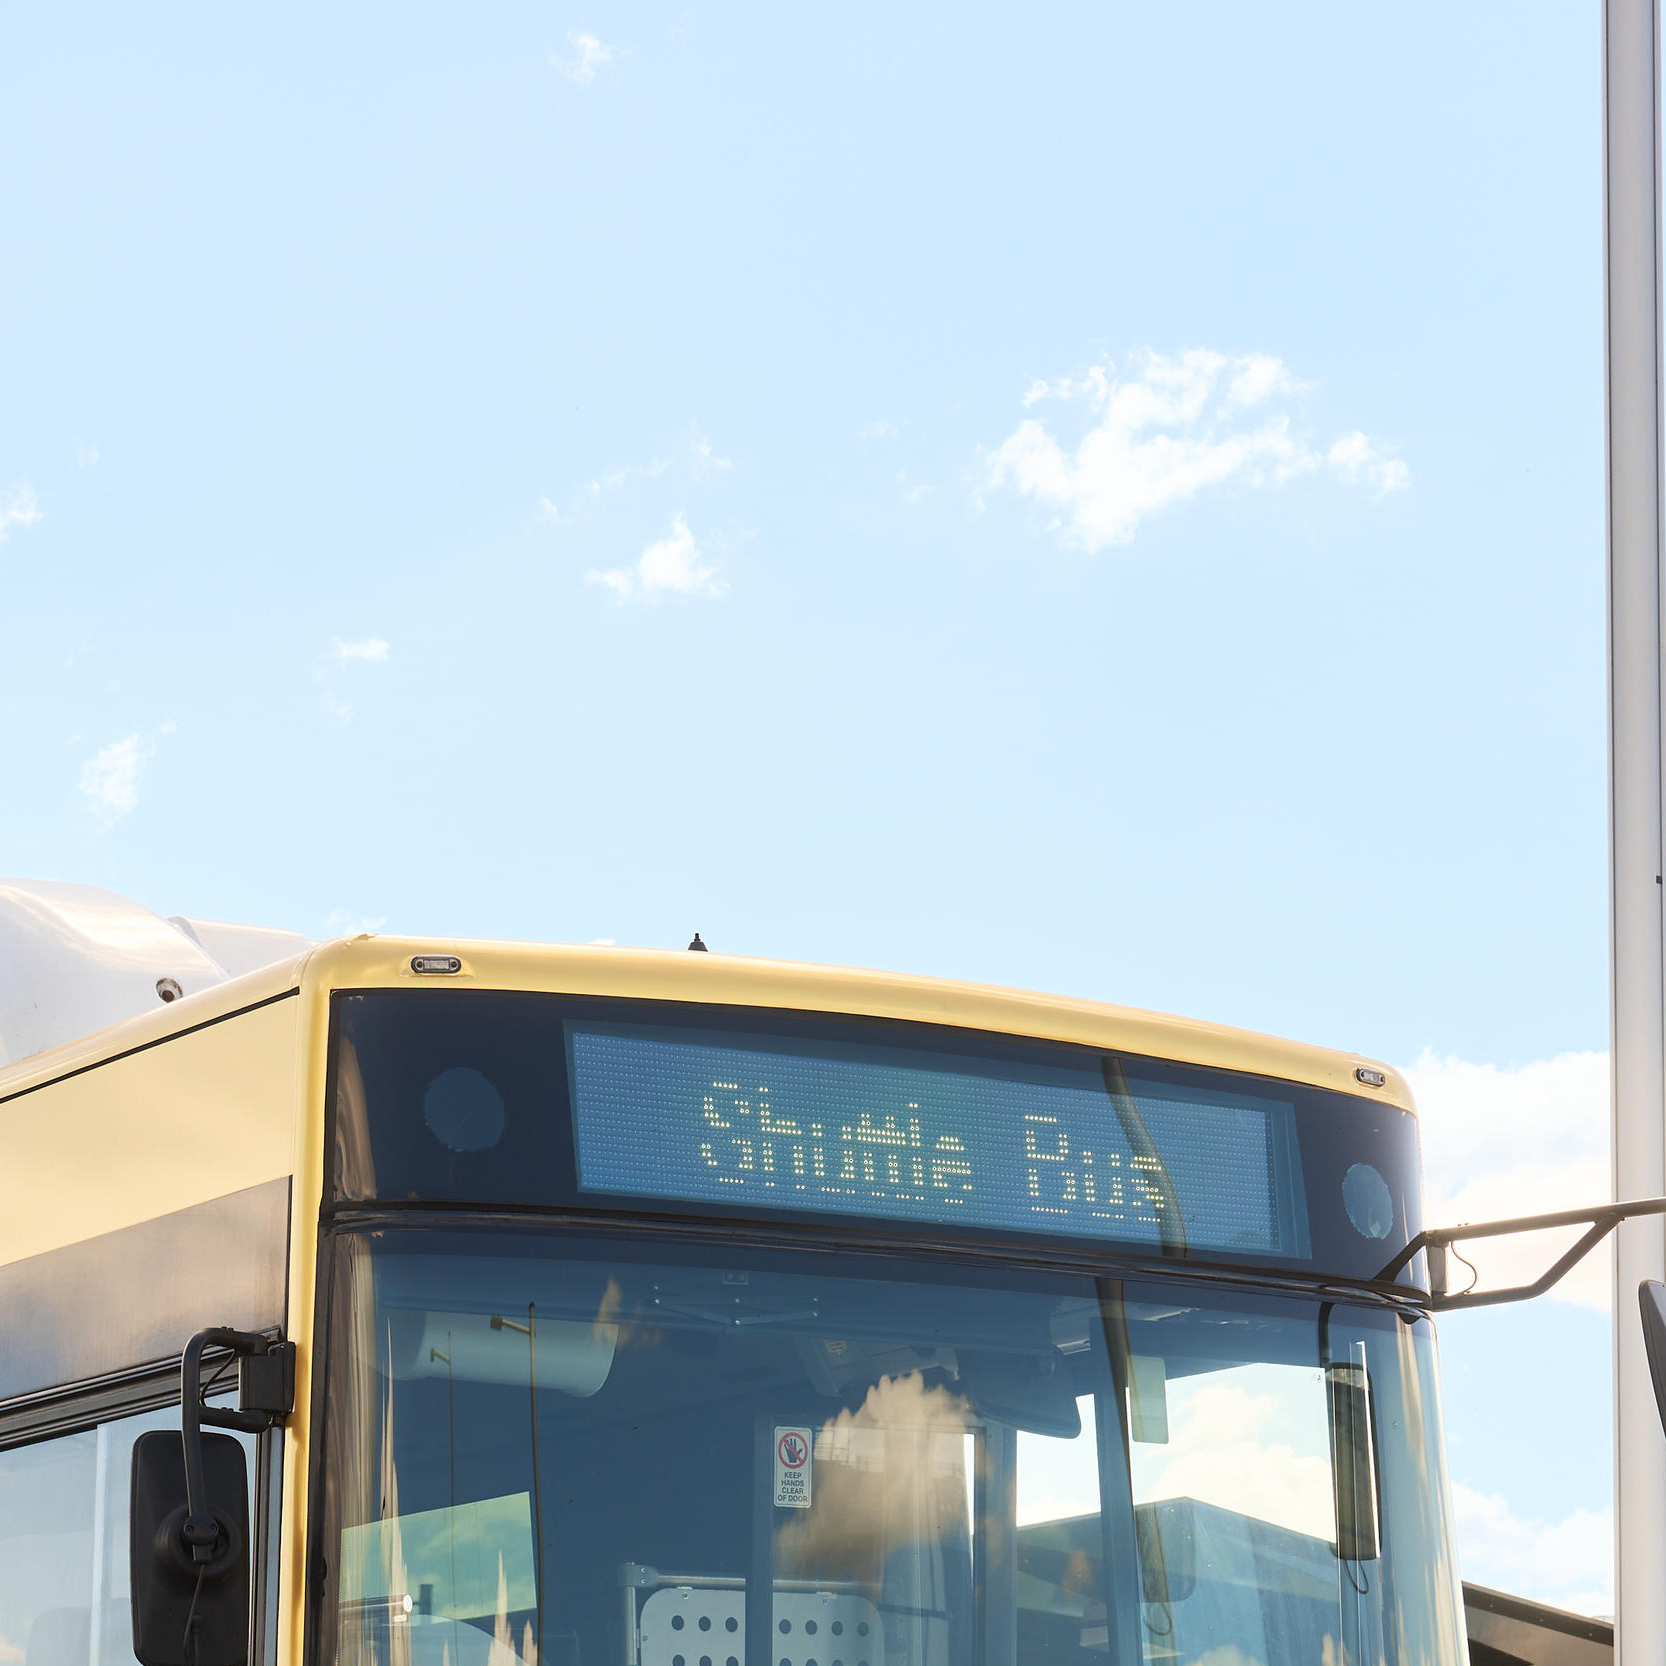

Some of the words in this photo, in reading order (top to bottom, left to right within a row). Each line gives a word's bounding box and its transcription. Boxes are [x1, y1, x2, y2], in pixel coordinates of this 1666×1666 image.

[701, 1081, 974, 1204] Shuttle
[1022, 1114, 1167, 1223] Bus
[788, 1495, 808, 1503] DOOR
